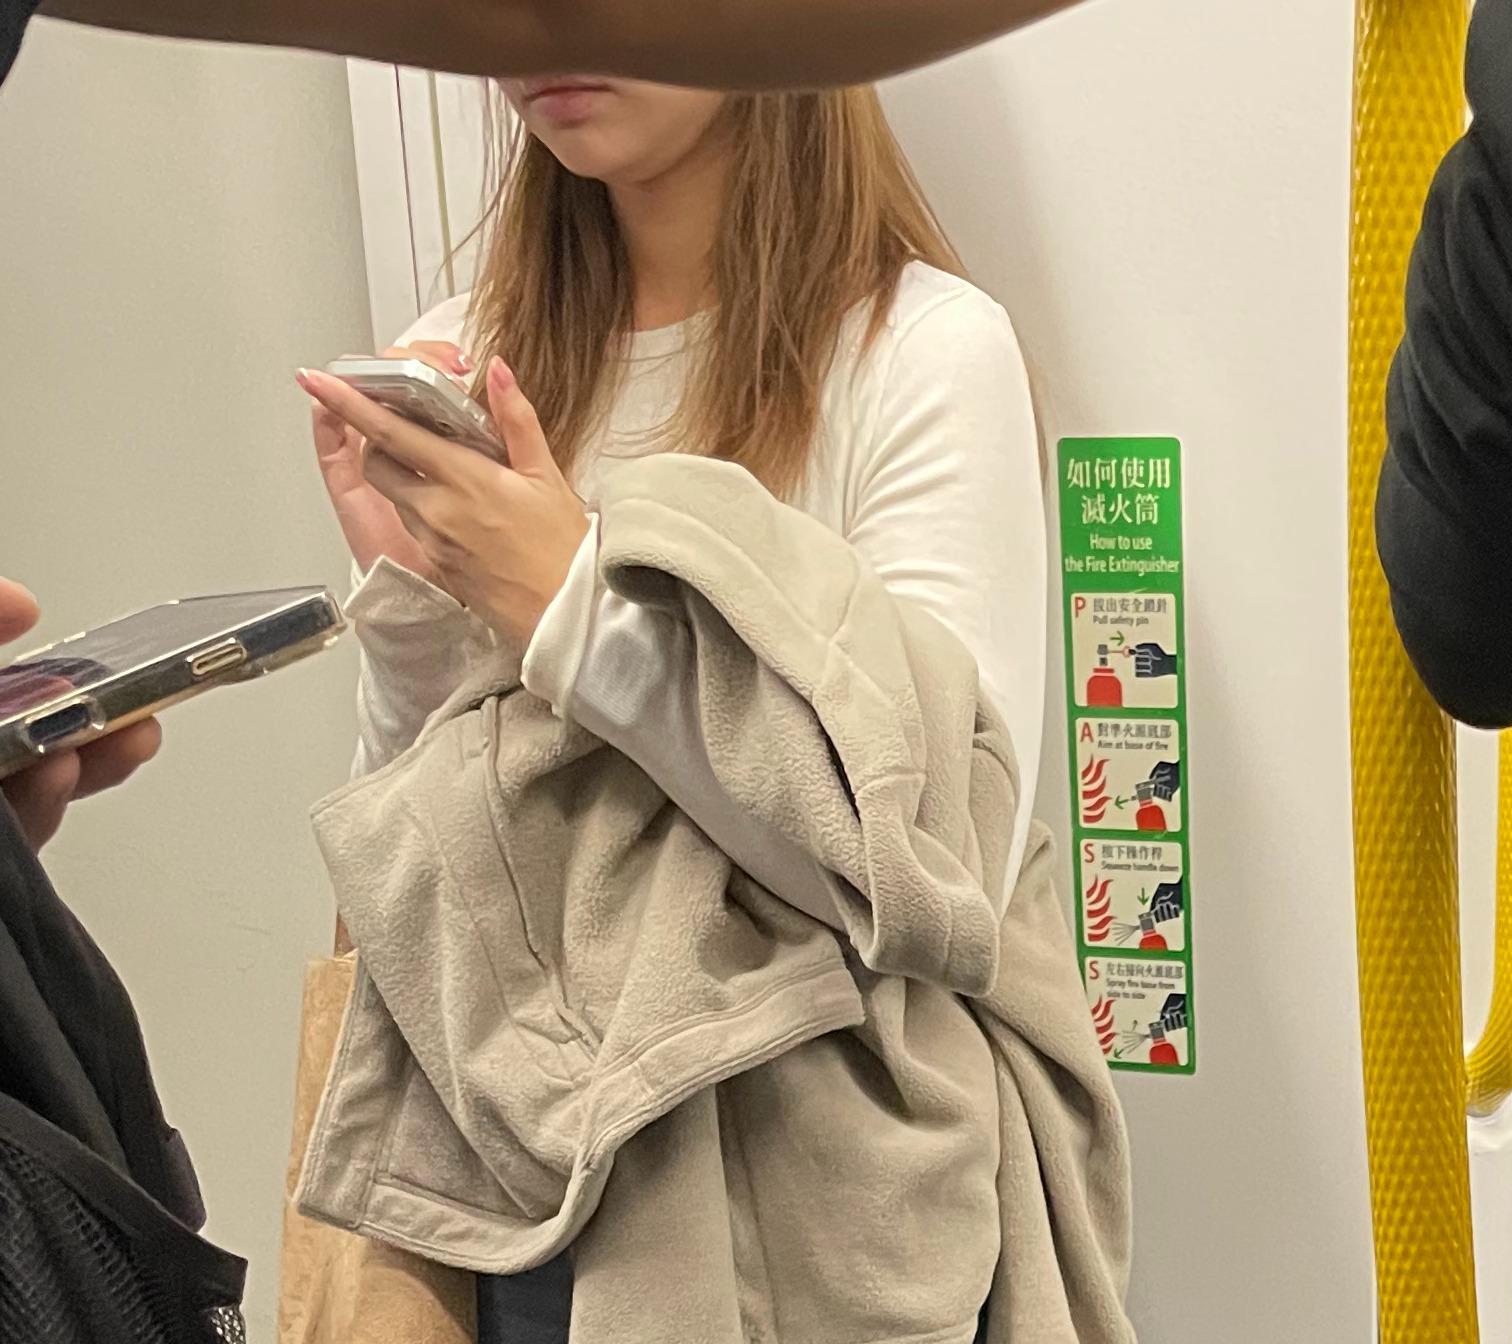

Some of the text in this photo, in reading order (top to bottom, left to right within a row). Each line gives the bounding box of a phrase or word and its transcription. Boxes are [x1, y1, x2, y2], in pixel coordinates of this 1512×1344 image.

[1067, 457, 1171, 490] 如何使用
[1081, 493, 1160, 525] 滅火筒
[1089, 533, 1153, 550] How to use
[1064, 555, 1180, 577] the Fire Extinguisher
[1074, 596, 1086, 618] P
[1093, 615, 1108, 624] Pull
[1136, 616, 1149, 627] pin
[1080, 721, 1094, 743] A
[1097, 740, 1113, 749] Aim
[1115, 741, 1123, 749] at
[1145, 741, 1154, 750] of
[1084, 843, 1095, 864] S
[1089, 960, 1100, 980] S
